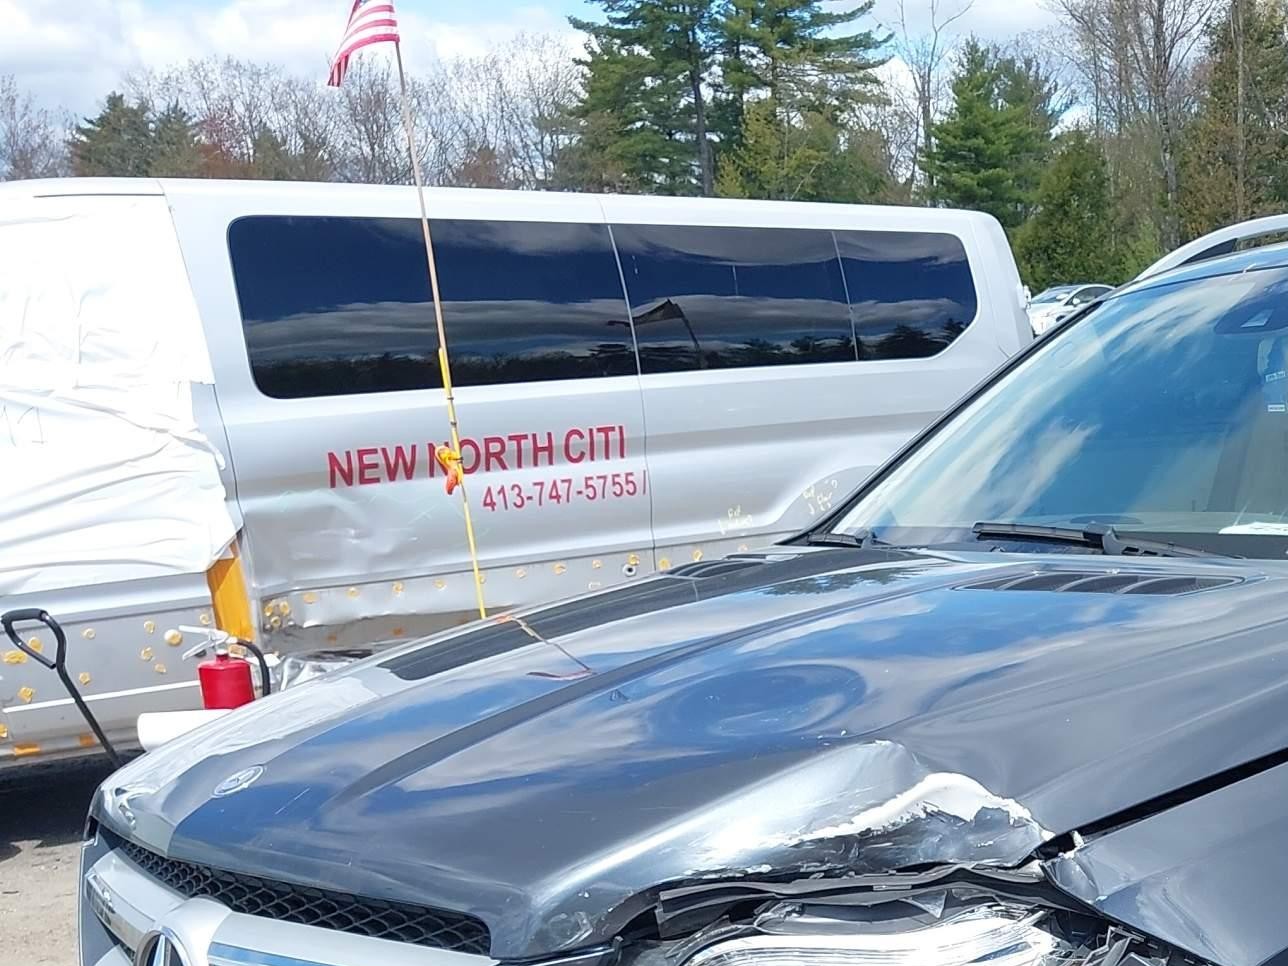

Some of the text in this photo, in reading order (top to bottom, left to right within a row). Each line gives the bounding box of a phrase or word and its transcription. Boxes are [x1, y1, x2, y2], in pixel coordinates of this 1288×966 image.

[327, 425, 626, 489] NEW NORTH CITI
[483, 471, 637, 511] 413-747-5755
